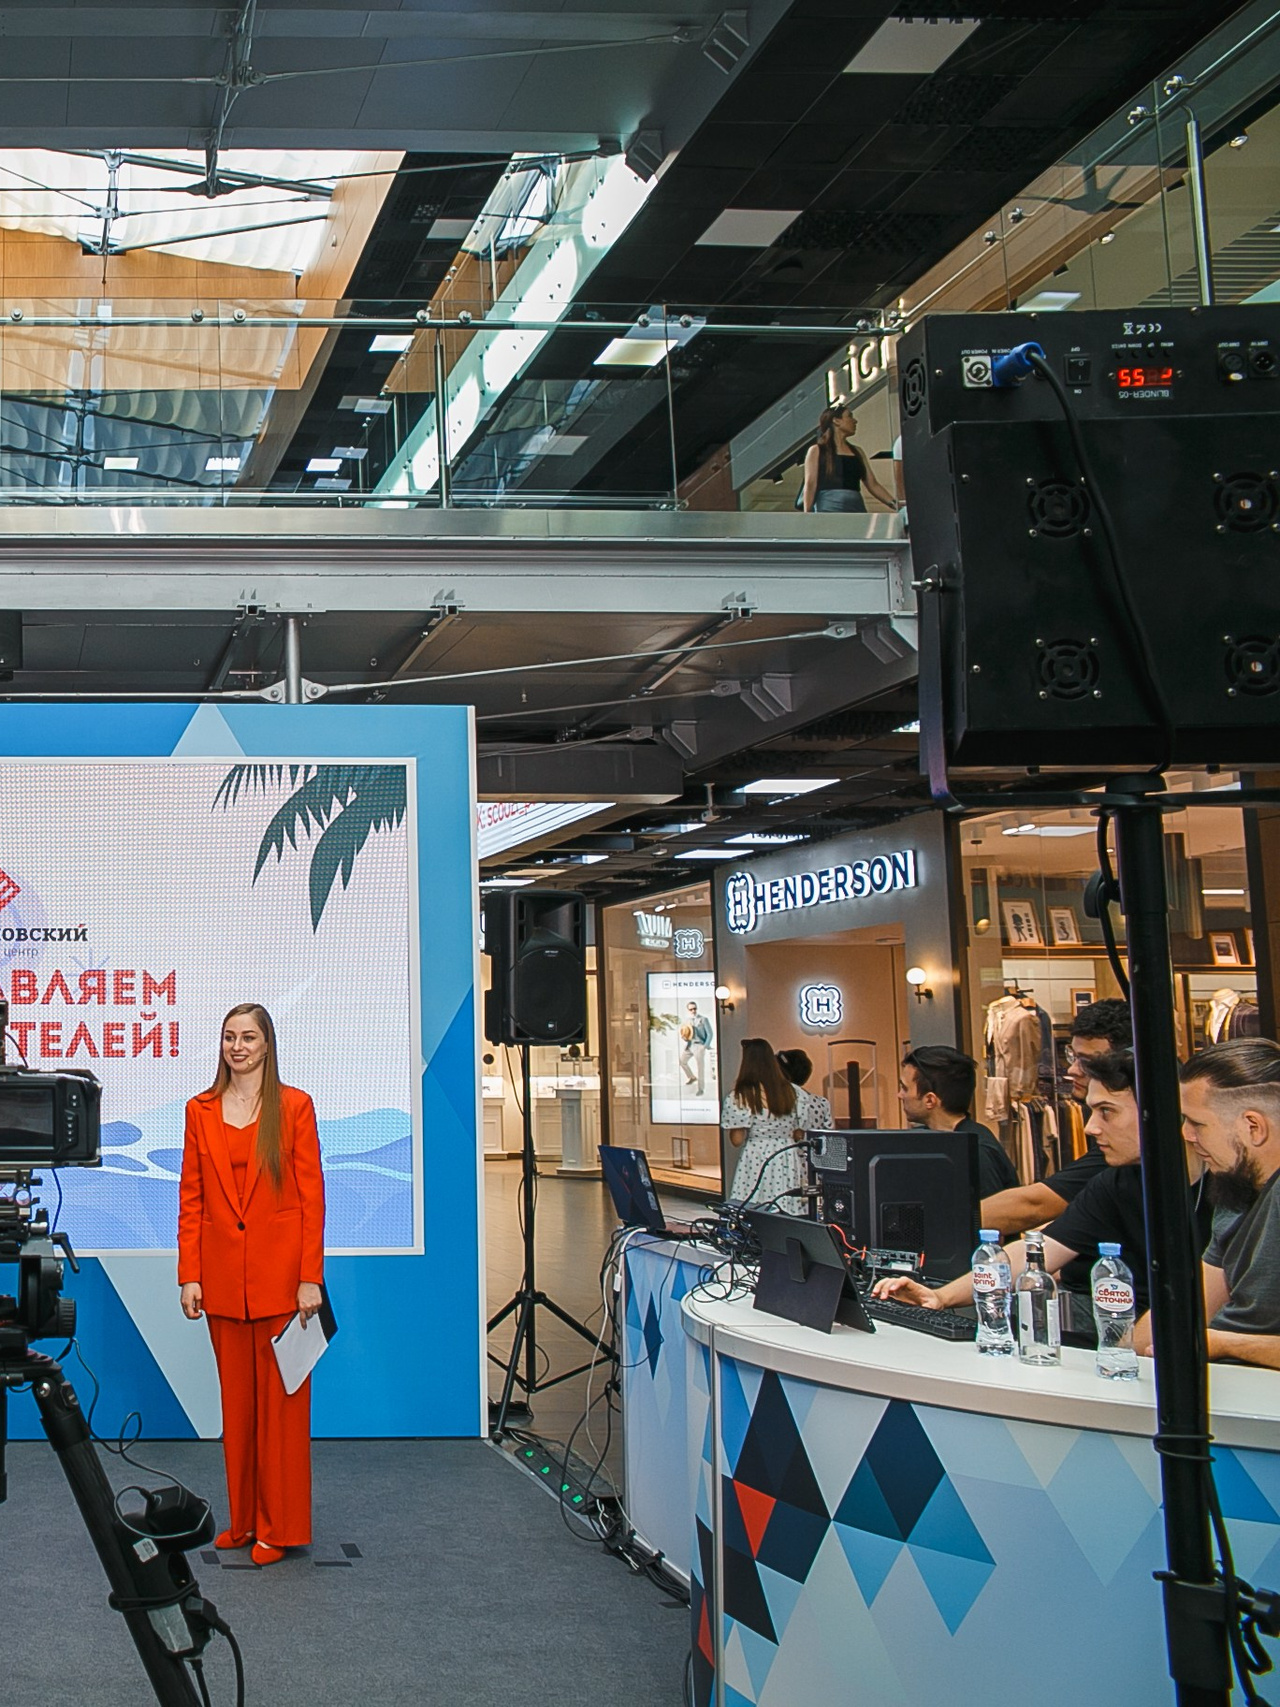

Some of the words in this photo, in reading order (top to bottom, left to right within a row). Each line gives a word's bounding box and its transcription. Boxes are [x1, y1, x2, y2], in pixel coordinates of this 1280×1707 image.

[1118, 389, 1170, 399] BLINDER-05
[753, 849, 916, 915] HENDERSON
[4, 945, 39, 958] центр
